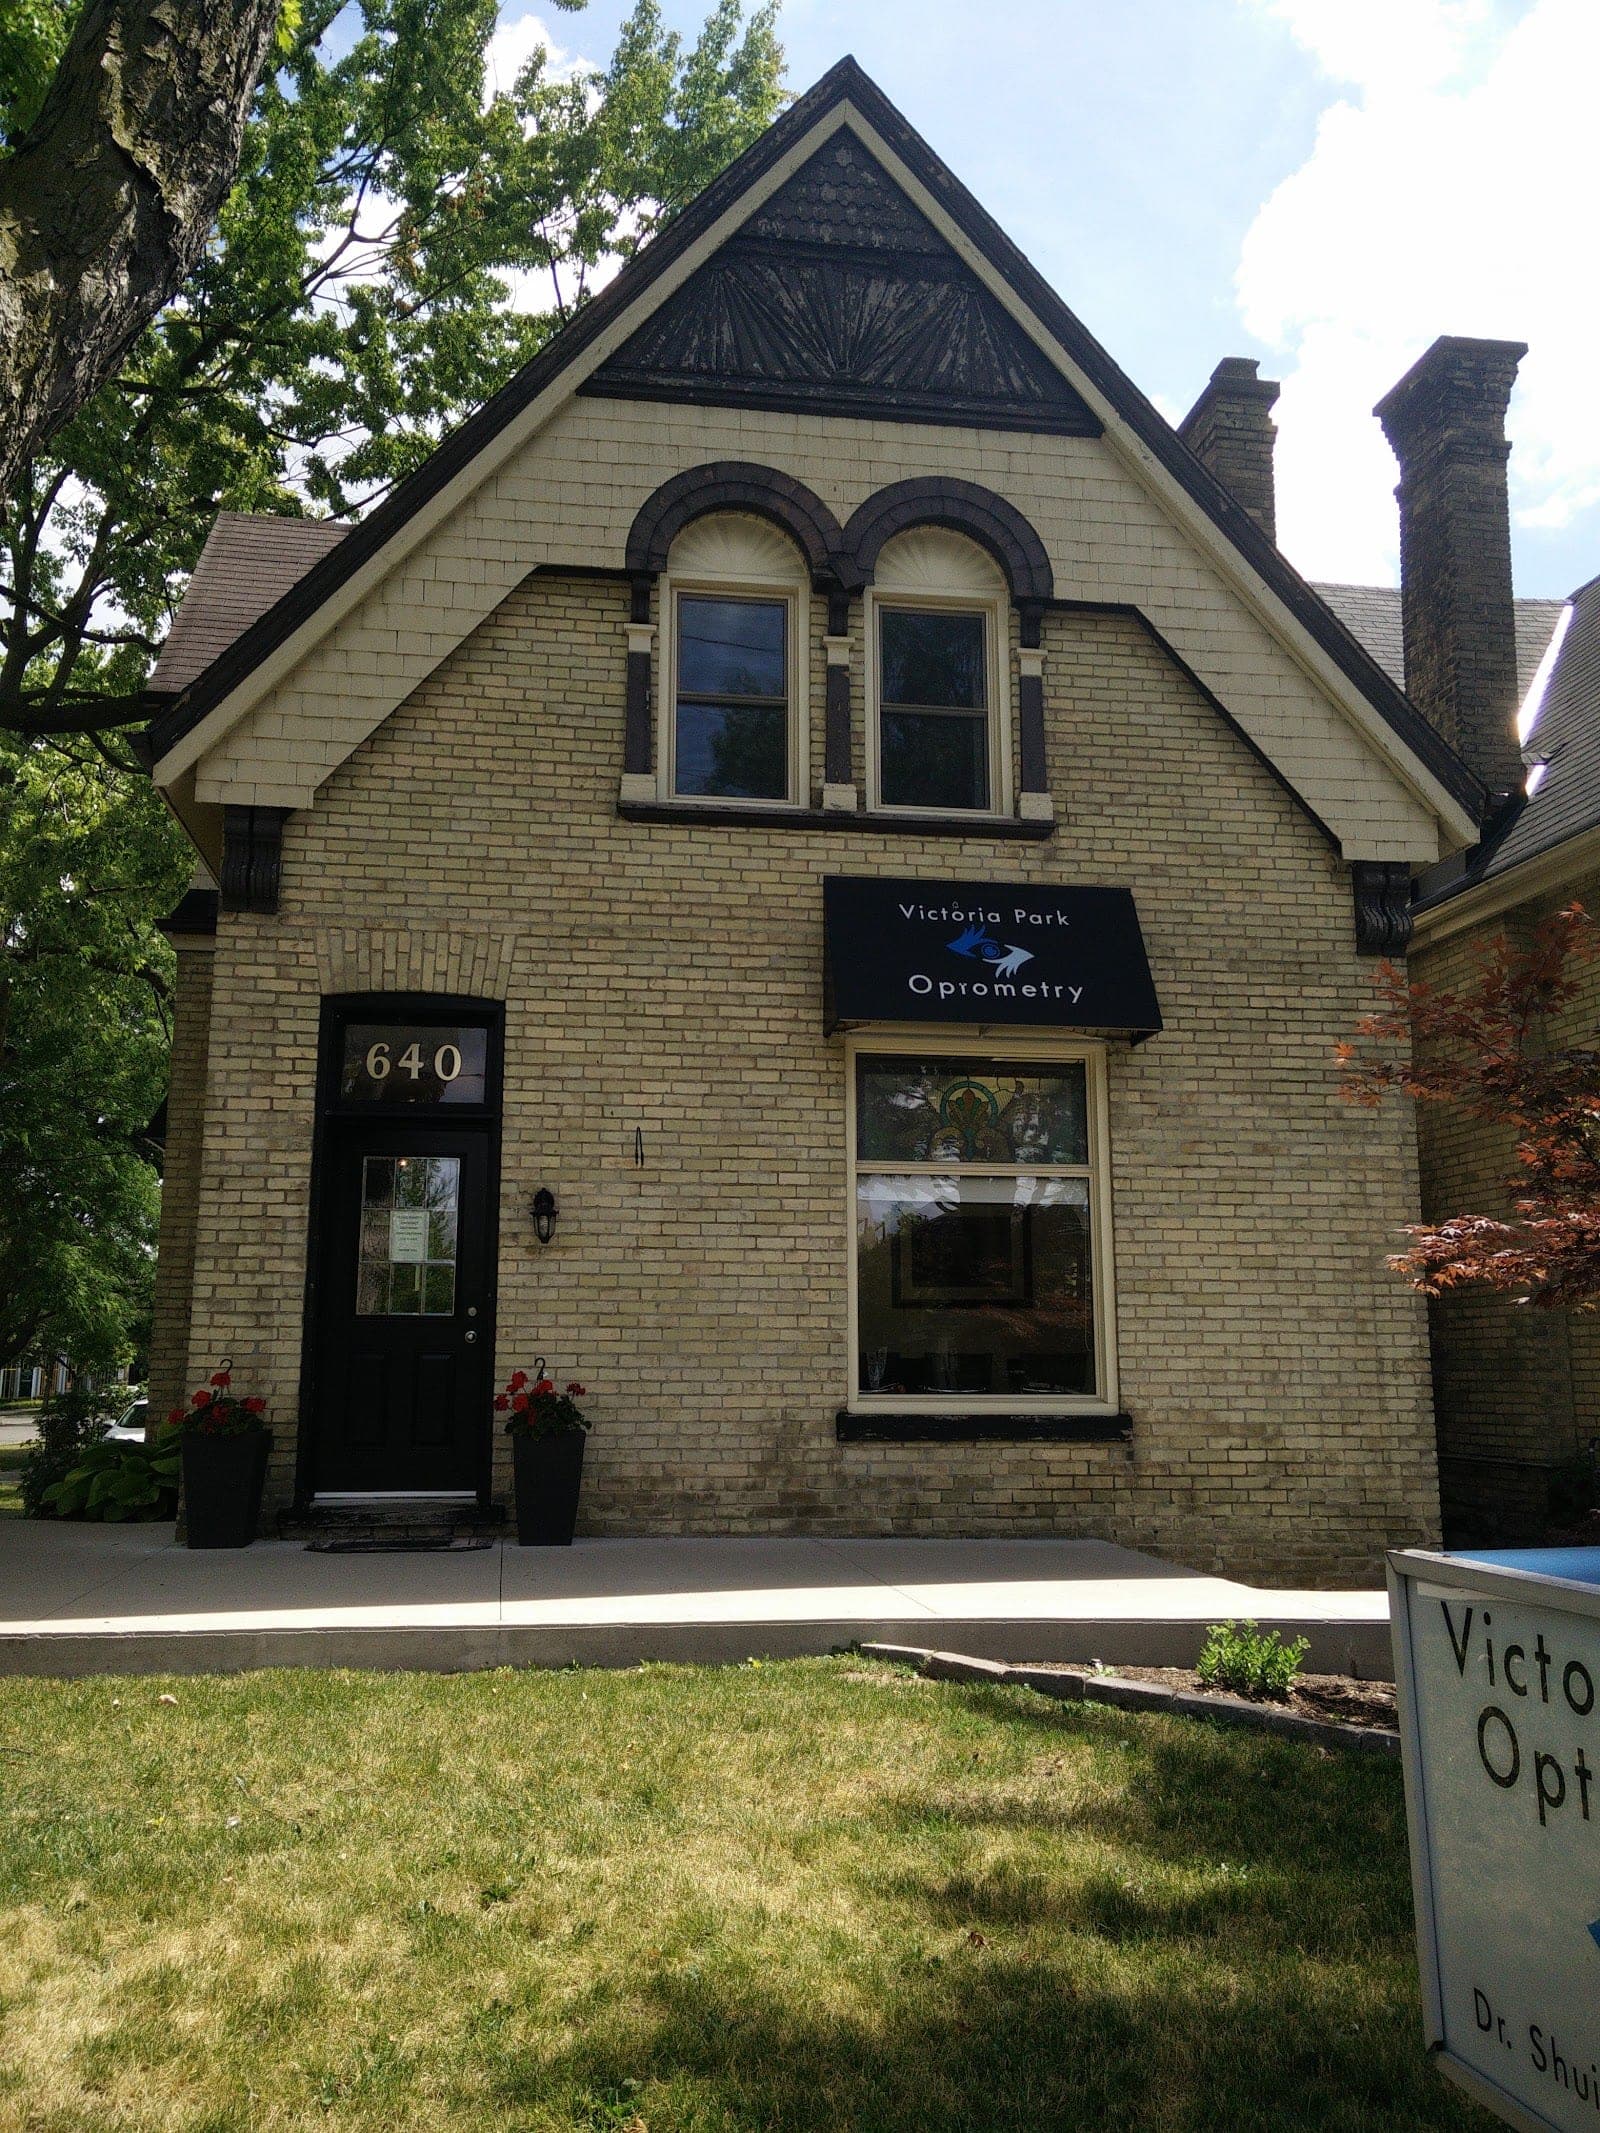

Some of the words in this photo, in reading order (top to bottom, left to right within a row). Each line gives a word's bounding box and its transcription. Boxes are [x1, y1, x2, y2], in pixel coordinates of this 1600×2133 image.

[898, 903, 1001, 924] Victoria
[1014, 908, 1070, 927] Park
[365, 1042, 462, 1081] 640
[1440, 1600, 1595, 1716] Victo
[1476, 1705, 1593, 1828] Opt
[1473, 1986, 1513, 2051] Dr.
